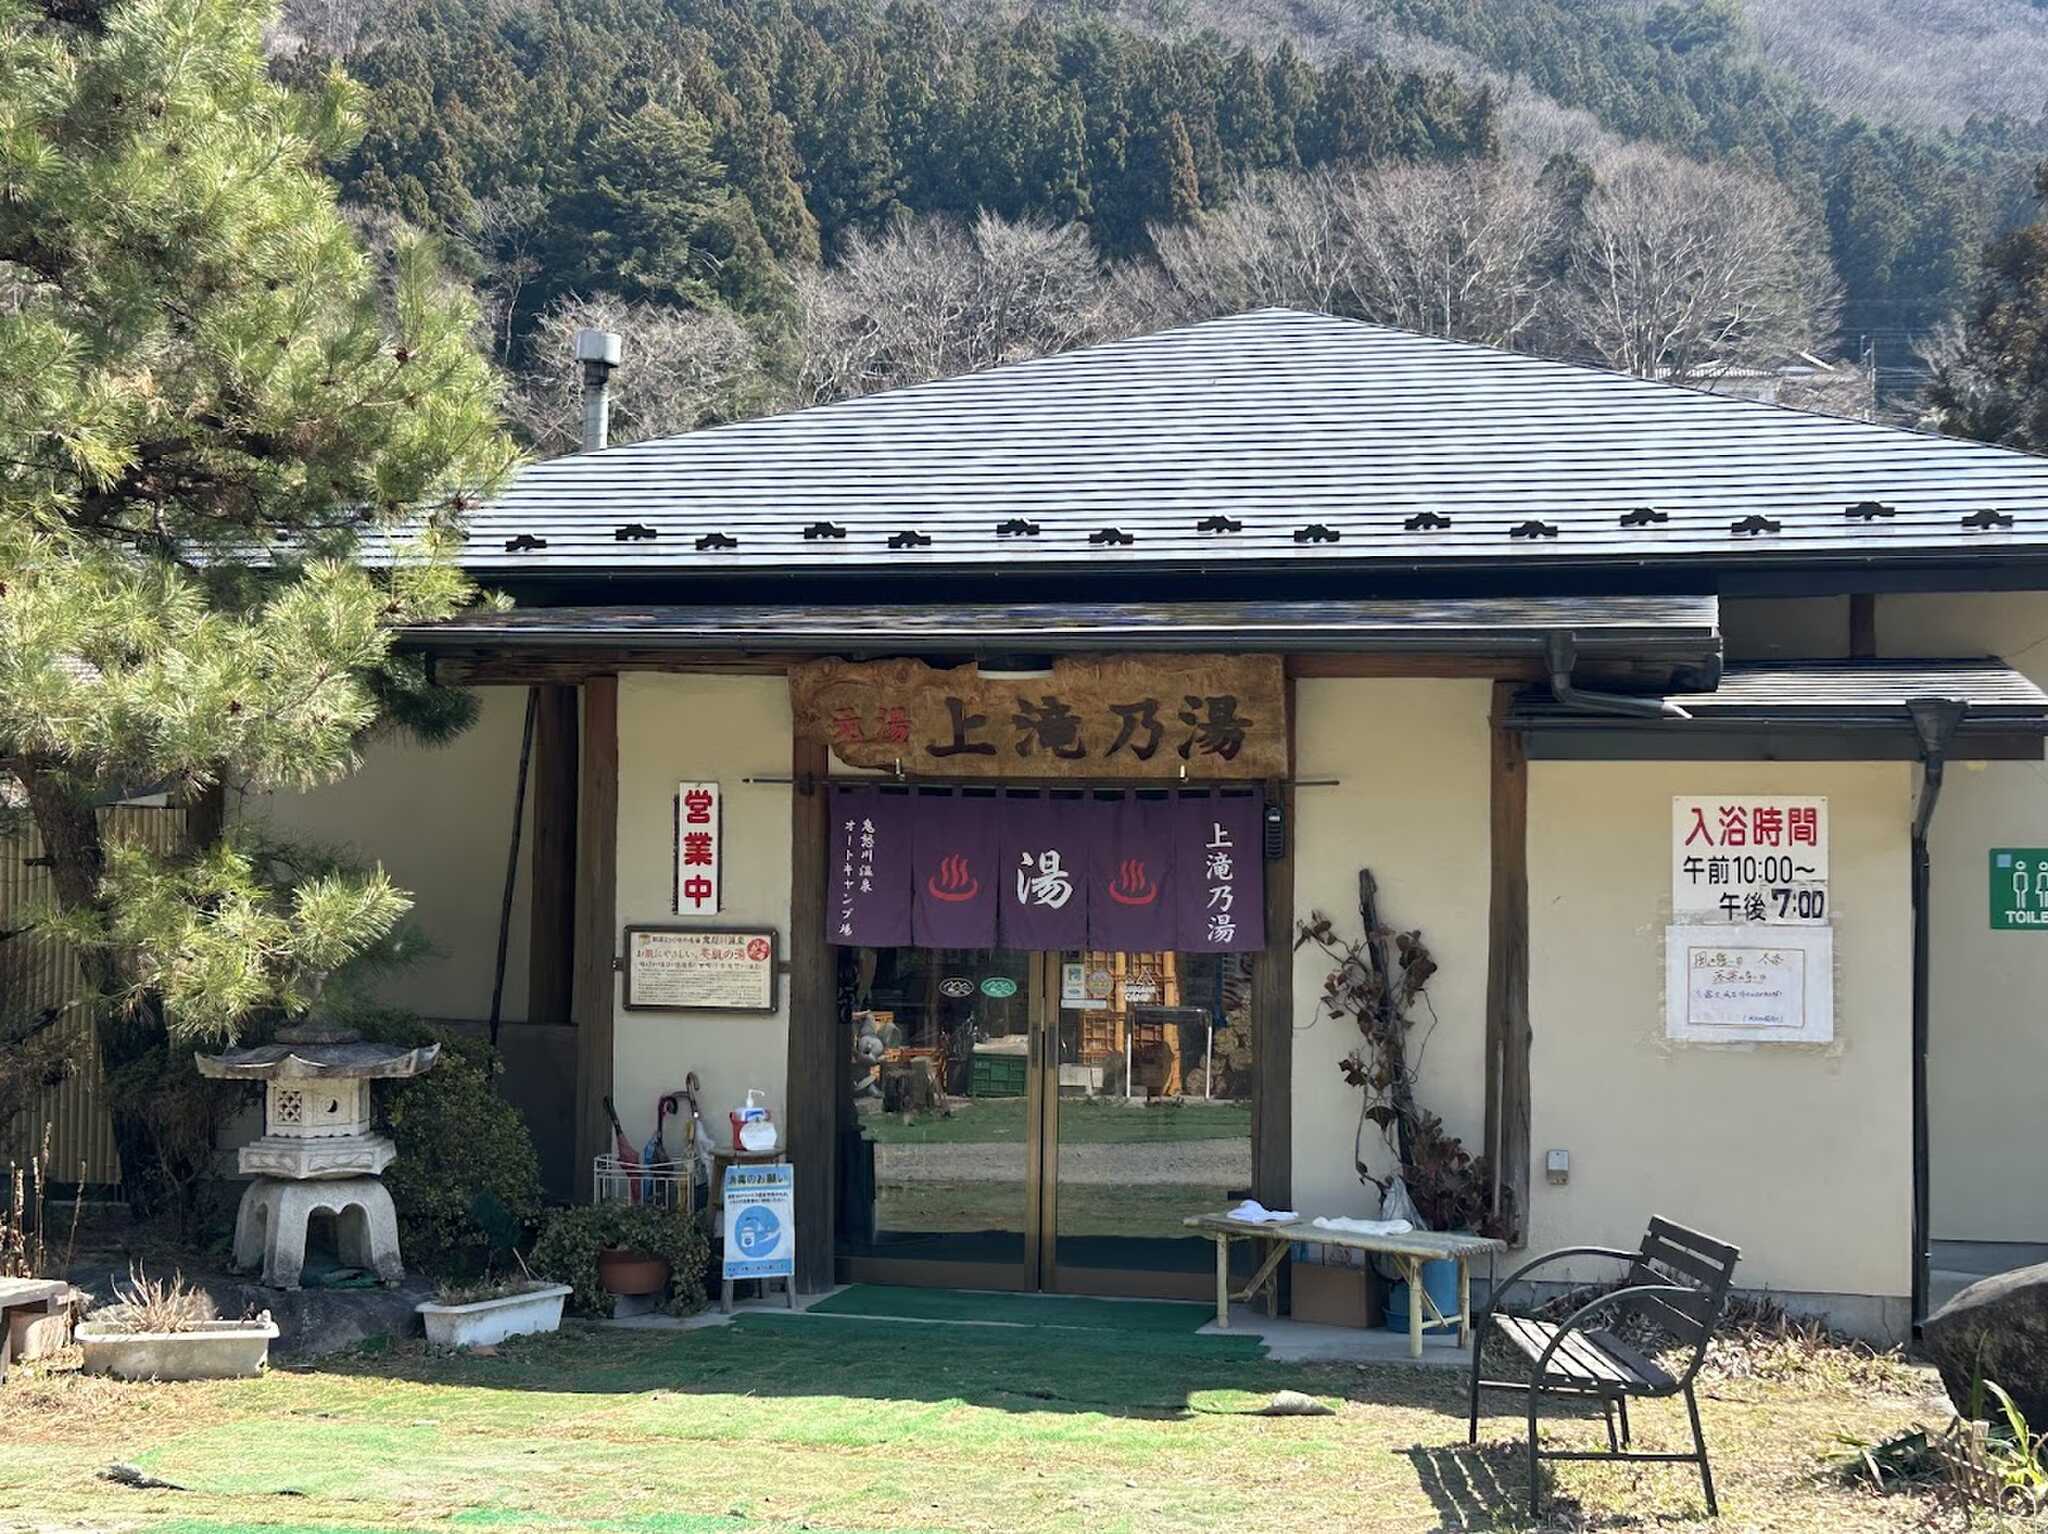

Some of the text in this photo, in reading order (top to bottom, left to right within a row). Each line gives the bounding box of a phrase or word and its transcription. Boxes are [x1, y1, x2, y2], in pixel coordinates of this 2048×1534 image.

[925, 695, 1253, 761] 上滝乃湯
[684, 789, 713, 908] 営業中
[859, 818, 875, 892] 鬼怒川温泉
[1685, 806, 1817, 846] 入浴時間
[839, 819, 854, 936] オートキャンプ場
[1017, 850, 1074, 910] 湯
[1206, 823, 1236, 943] 上滝乃湯
[2005, 911, 2048, 923] TOILE
